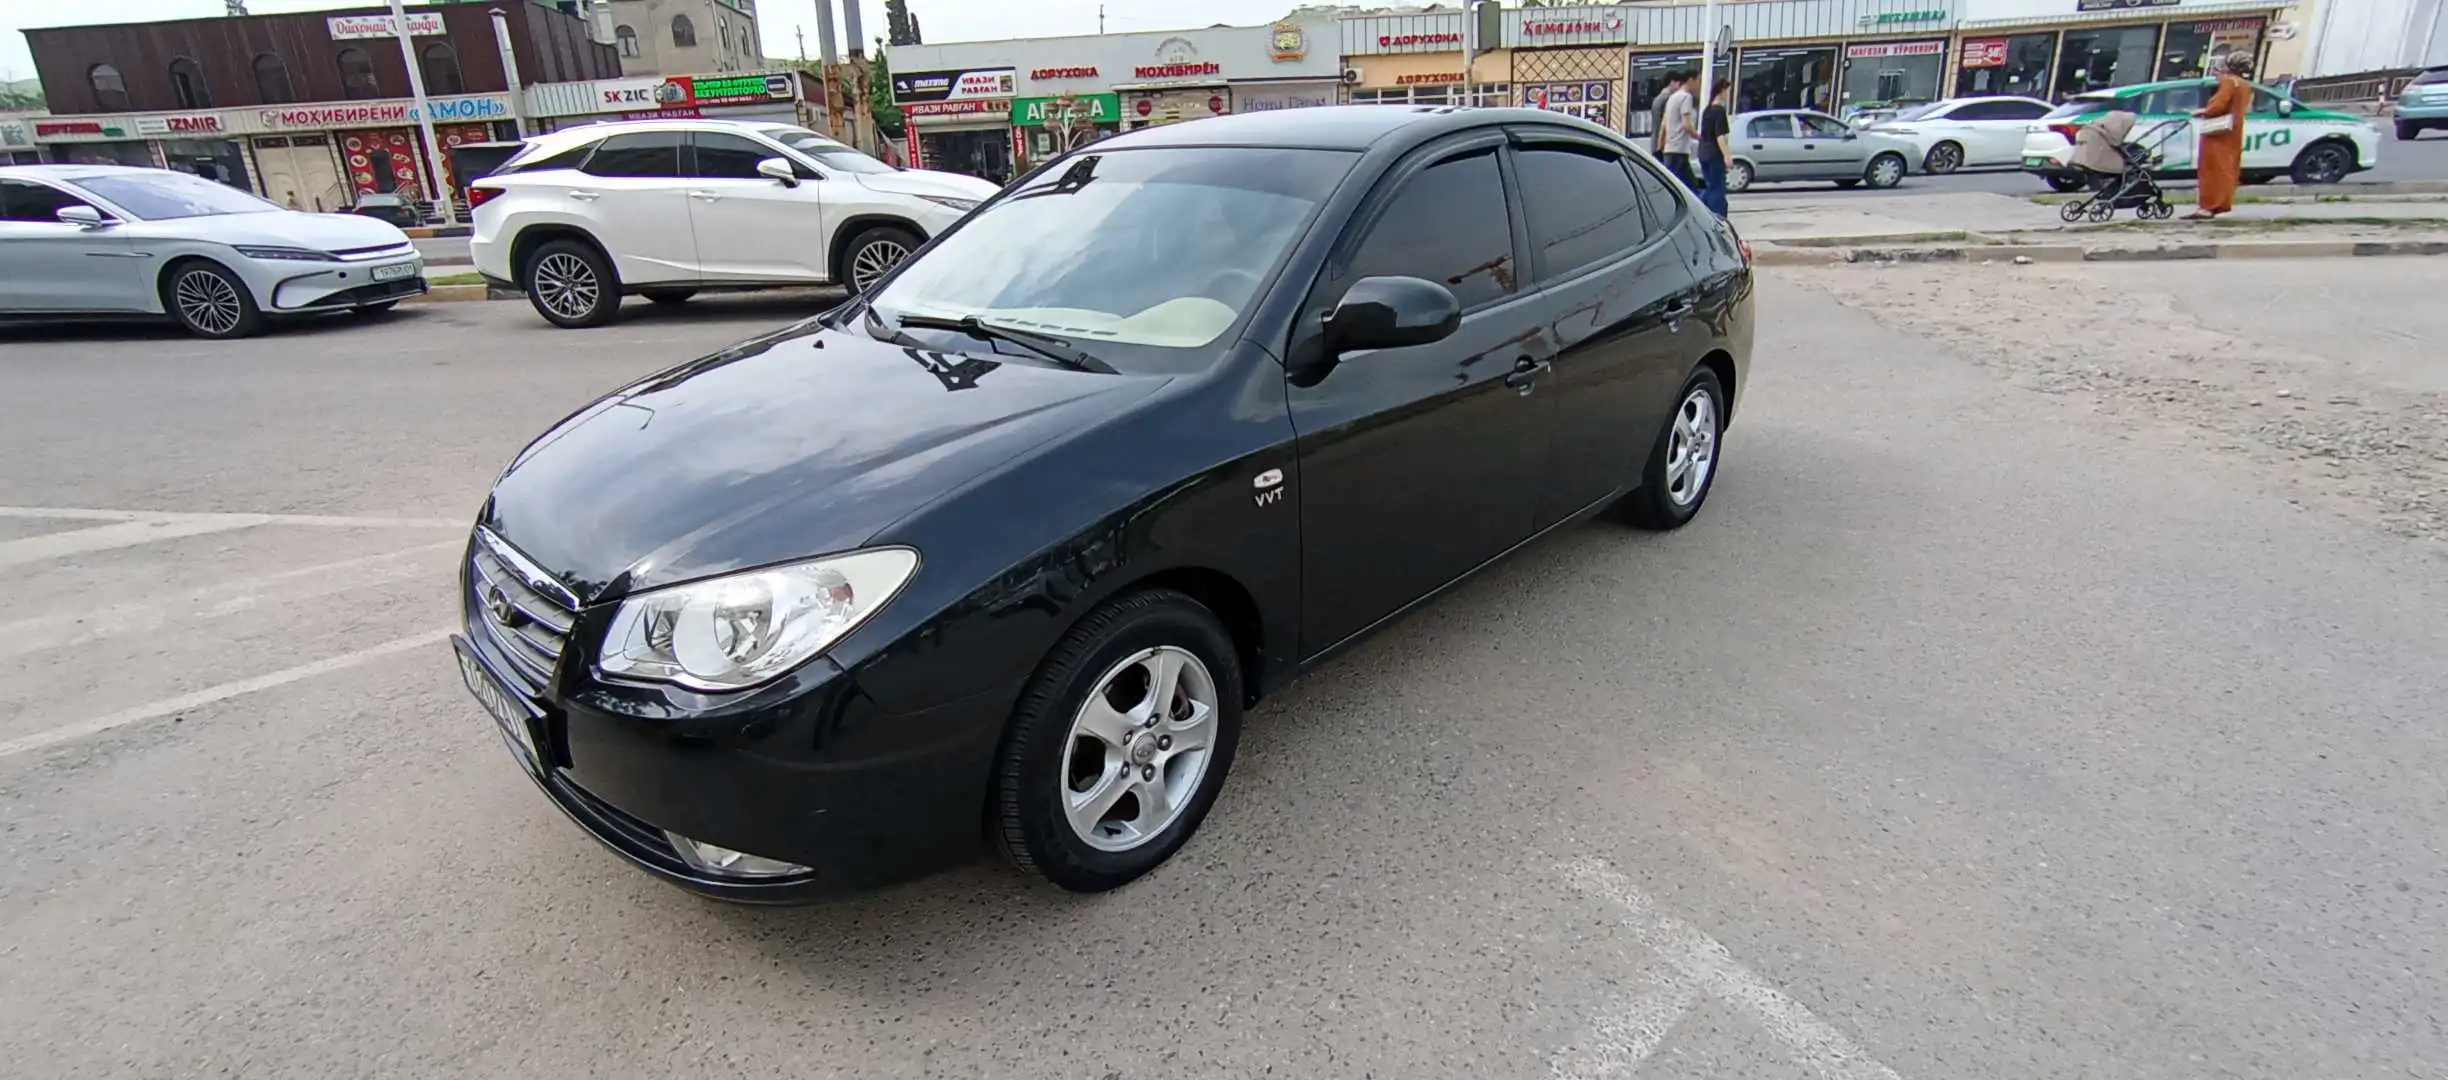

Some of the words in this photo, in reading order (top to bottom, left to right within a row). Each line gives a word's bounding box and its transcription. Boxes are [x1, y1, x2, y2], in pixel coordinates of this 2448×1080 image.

[1393, 33, 1460, 45] ДОРУХОНА
[1031, 66, 1099, 80] ДОРУХОНА
[1396, 73, 1464, 84] ДОРУХОНА
[962, 76, 995, 84] ИВАЗИ
[604, 90, 622, 103] SK
[624, 89, 650, 102] ZIC
[961, 86, 998, 94] РАВГАН
[911, 103, 940, 114] ИВАЗИ
[942, 102, 976, 113] РАВГАН
[166, 116, 220, 131] IZMIR
[1255, 486, 1284, 507] VVT
